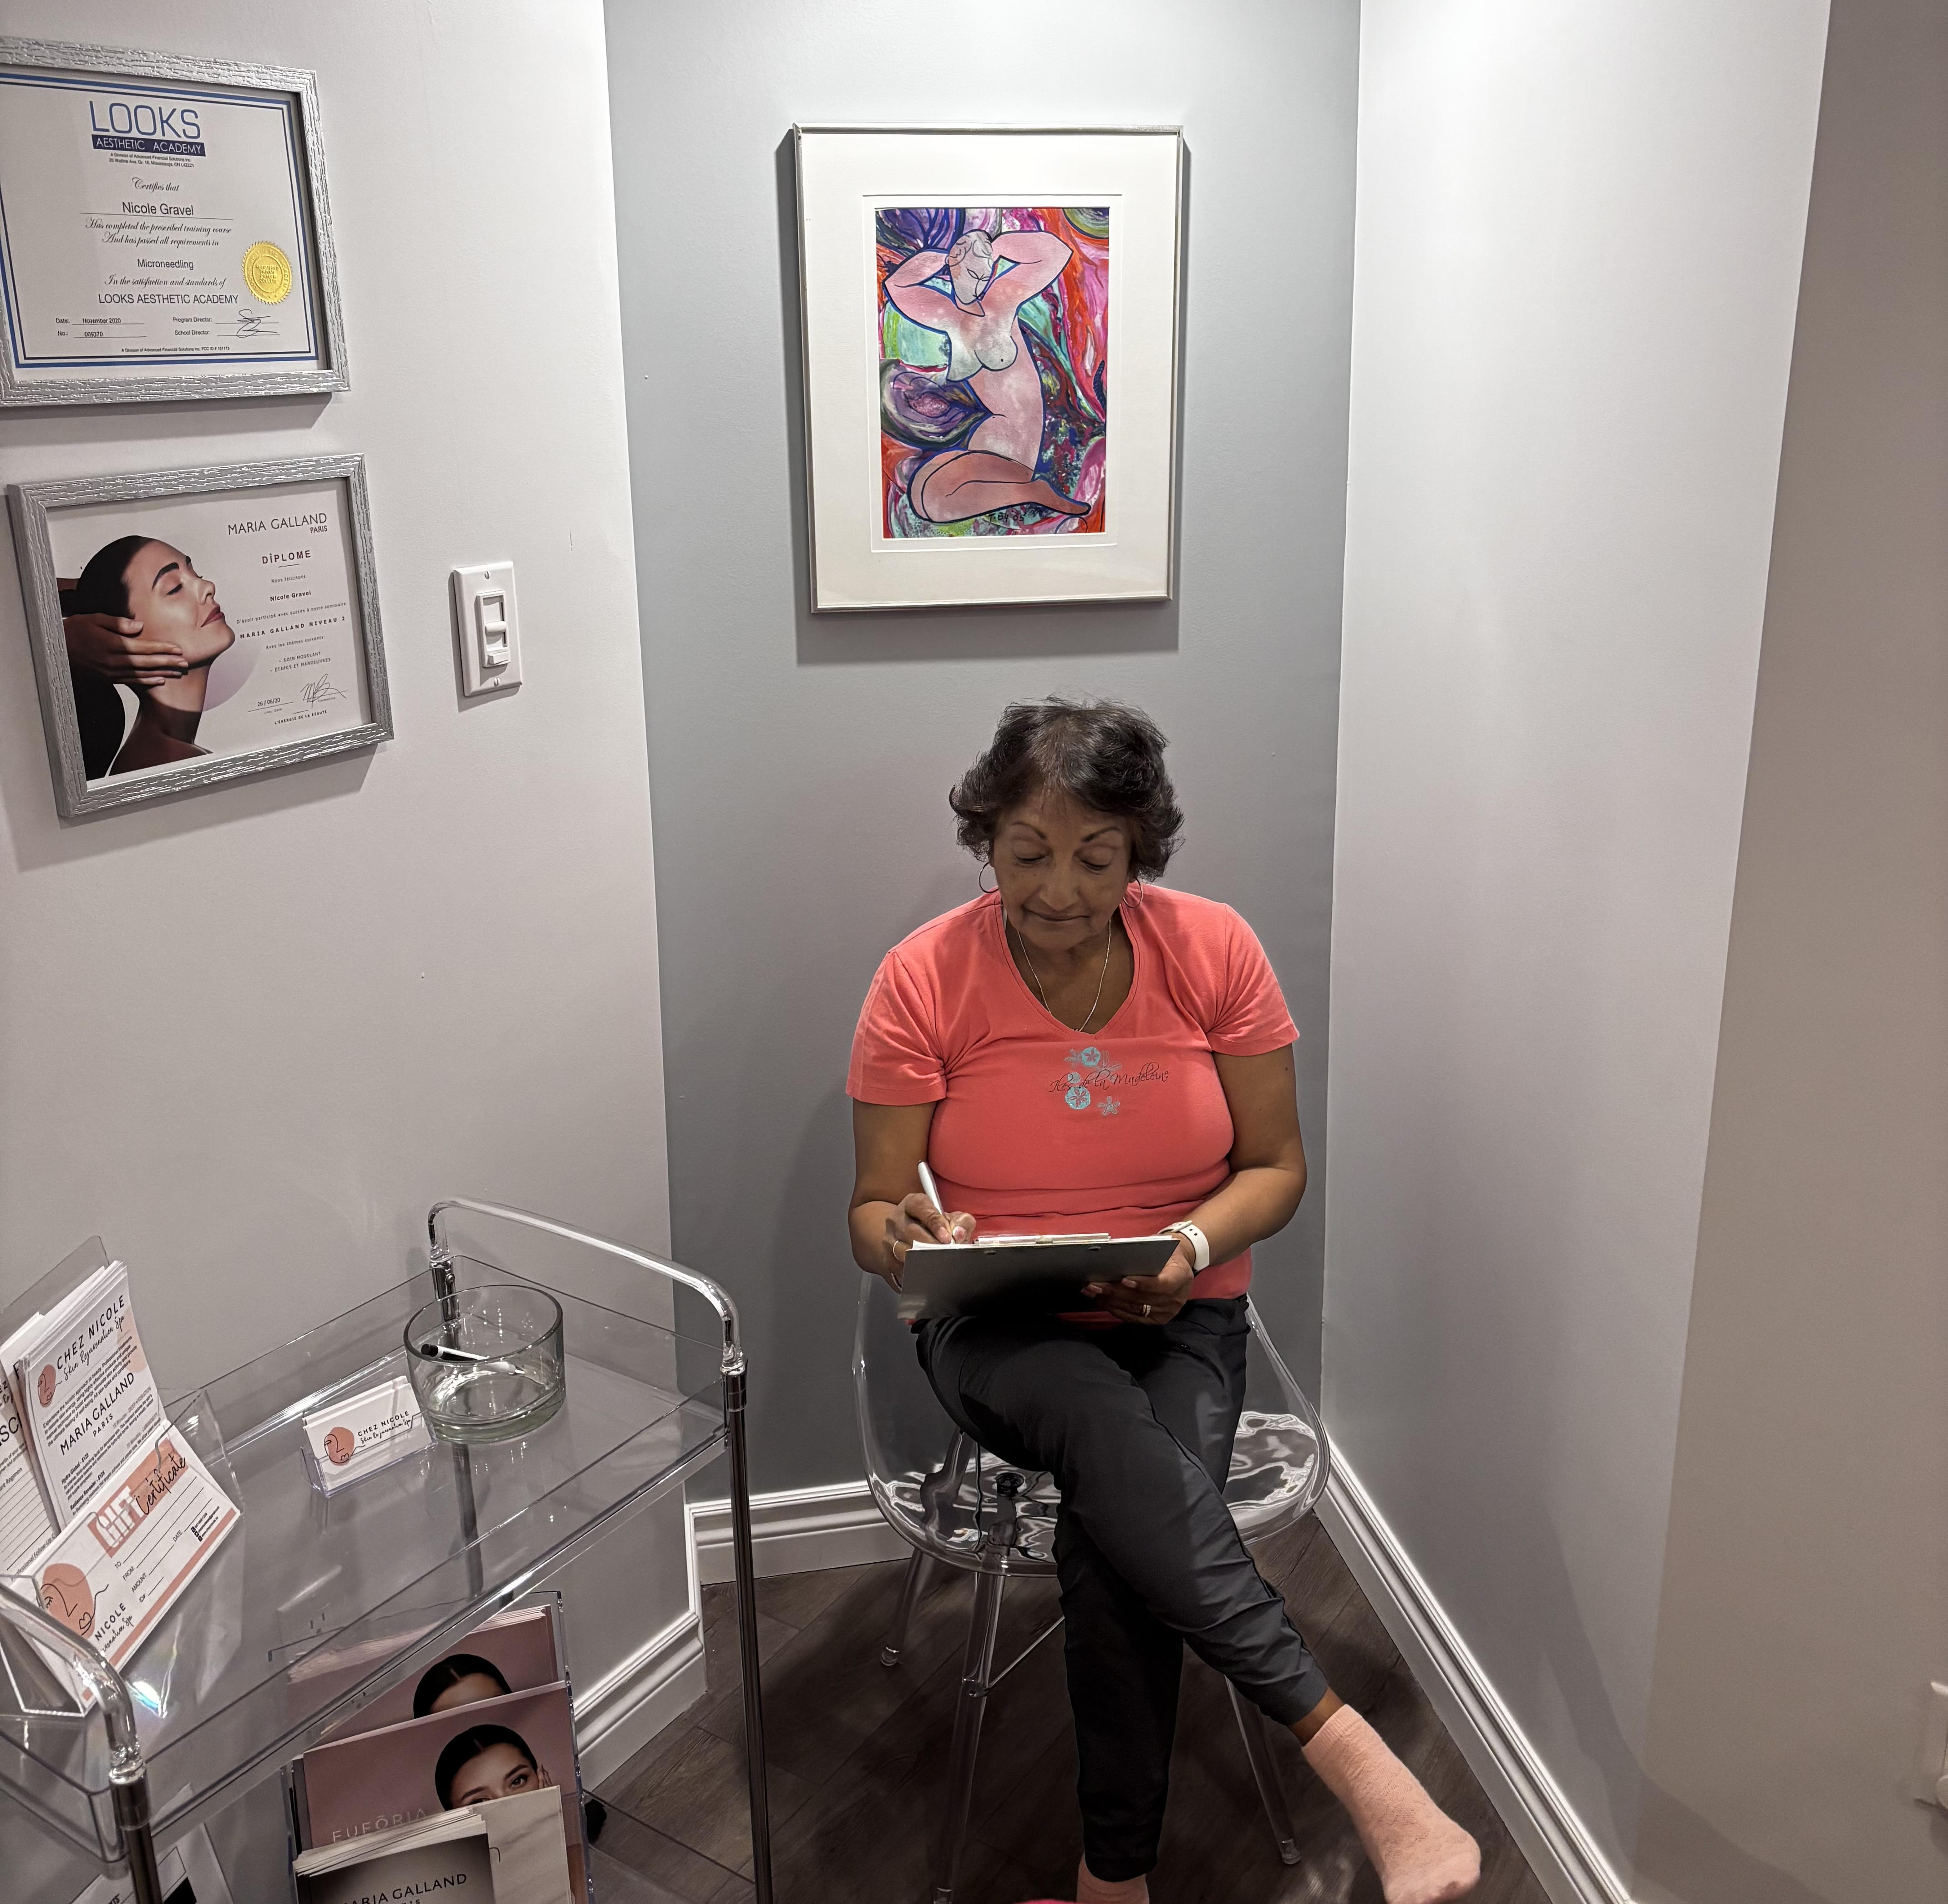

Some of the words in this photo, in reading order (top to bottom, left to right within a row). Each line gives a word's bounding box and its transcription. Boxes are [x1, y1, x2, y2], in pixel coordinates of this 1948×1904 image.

[90, 101, 200, 139] LOOKS
[96, 138, 145, 150] AESTHETIC
[153, 142, 201, 153] ACADEMY
[132, 177, 164, 193] Certifies
[166, 182, 179, 191] that
[122, 202, 156, 214] Nicole
[160, 203, 194, 216] Gravel
[102, 231, 123, 243] And
[125, 235, 136, 243] has
[160, 237, 168, 245] all
[171, 239, 211, 248] requirements
[106, 222, 138, 233] completed
[140, 222, 149, 230] the
[184, 225, 210, 237] training
[137, 258, 193, 270] Microneedling
[120, 276, 131, 285] the
[131, 277, 167, 288] satisfaction
[170, 277, 184, 285] and
[185, 277, 218, 286] standards
[218, 277, 226, 289] of
[98, 294, 134, 304] LOOKS
[137, 294, 190, 304] AESTHETIC
[193, 294, 238, 304] ACADEMY
[228, 521, 266, 535] MARIA
[271, 513, 327, 529] GALLAND
[262, 550, 311, 564] DÎPLOME
[240, 630, 265, 639] MARIA
[270, 623, 304, 633] GALLAND
[309, 618, 337, 627] NIVEAU
[1109, 1062, 1169, 1087] Madeleine
[57, 1334, 84, 1370] CHEZ
[88, 1295, 124, 1339] NICOLE
[64, 1362, 79, 1381] Skin
[115, 1316, 124, 1332] Spa
[60, 1419, 92, 1455] MARIA
[92, 1372, 135, 1420] GALLAND
[358, 1424, 378, 1437] CHEZ
[381, 1411, 409, 1426] NICOLE
[93, 1413, 113, 1438] PARIS
[96, 1485, 145, 1547] GIFT
[134, 1453, 186, 1515] Certificate
[113, 1560, 122, 1570] TO
[130, 1572, 148, 1593] AMOUNT
[171, 1529, 183, 1542] DATE
[121, 1565, 136, 1581] FROM
[95, 1603, 126, 1641] NICOLE
[122, 1615, 134, 1627] Spa
[392, 1874, 467, 1899] GALLAND
